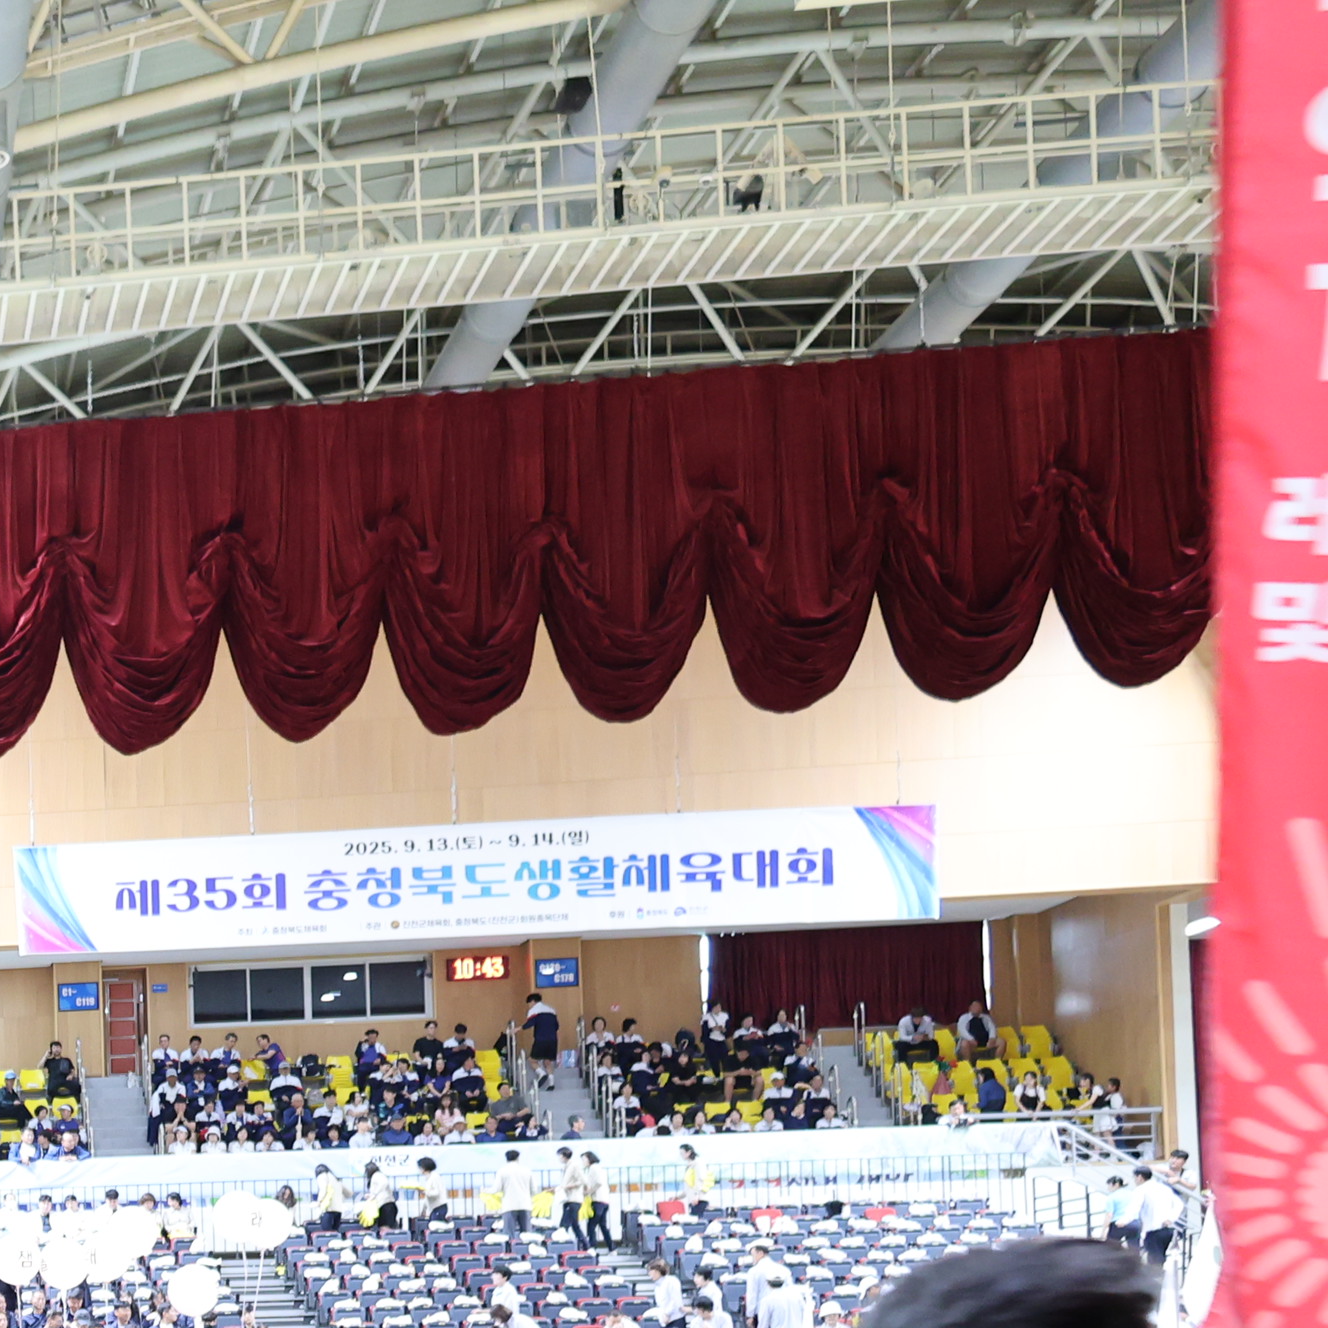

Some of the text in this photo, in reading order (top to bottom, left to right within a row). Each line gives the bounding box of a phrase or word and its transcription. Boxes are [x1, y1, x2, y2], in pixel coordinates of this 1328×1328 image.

[344, 841, 399, 856] 2025.
[115, 847, 835, 917] 제35회 충청북도생활체육대회
[453, 956, 504, 979] 10:43
